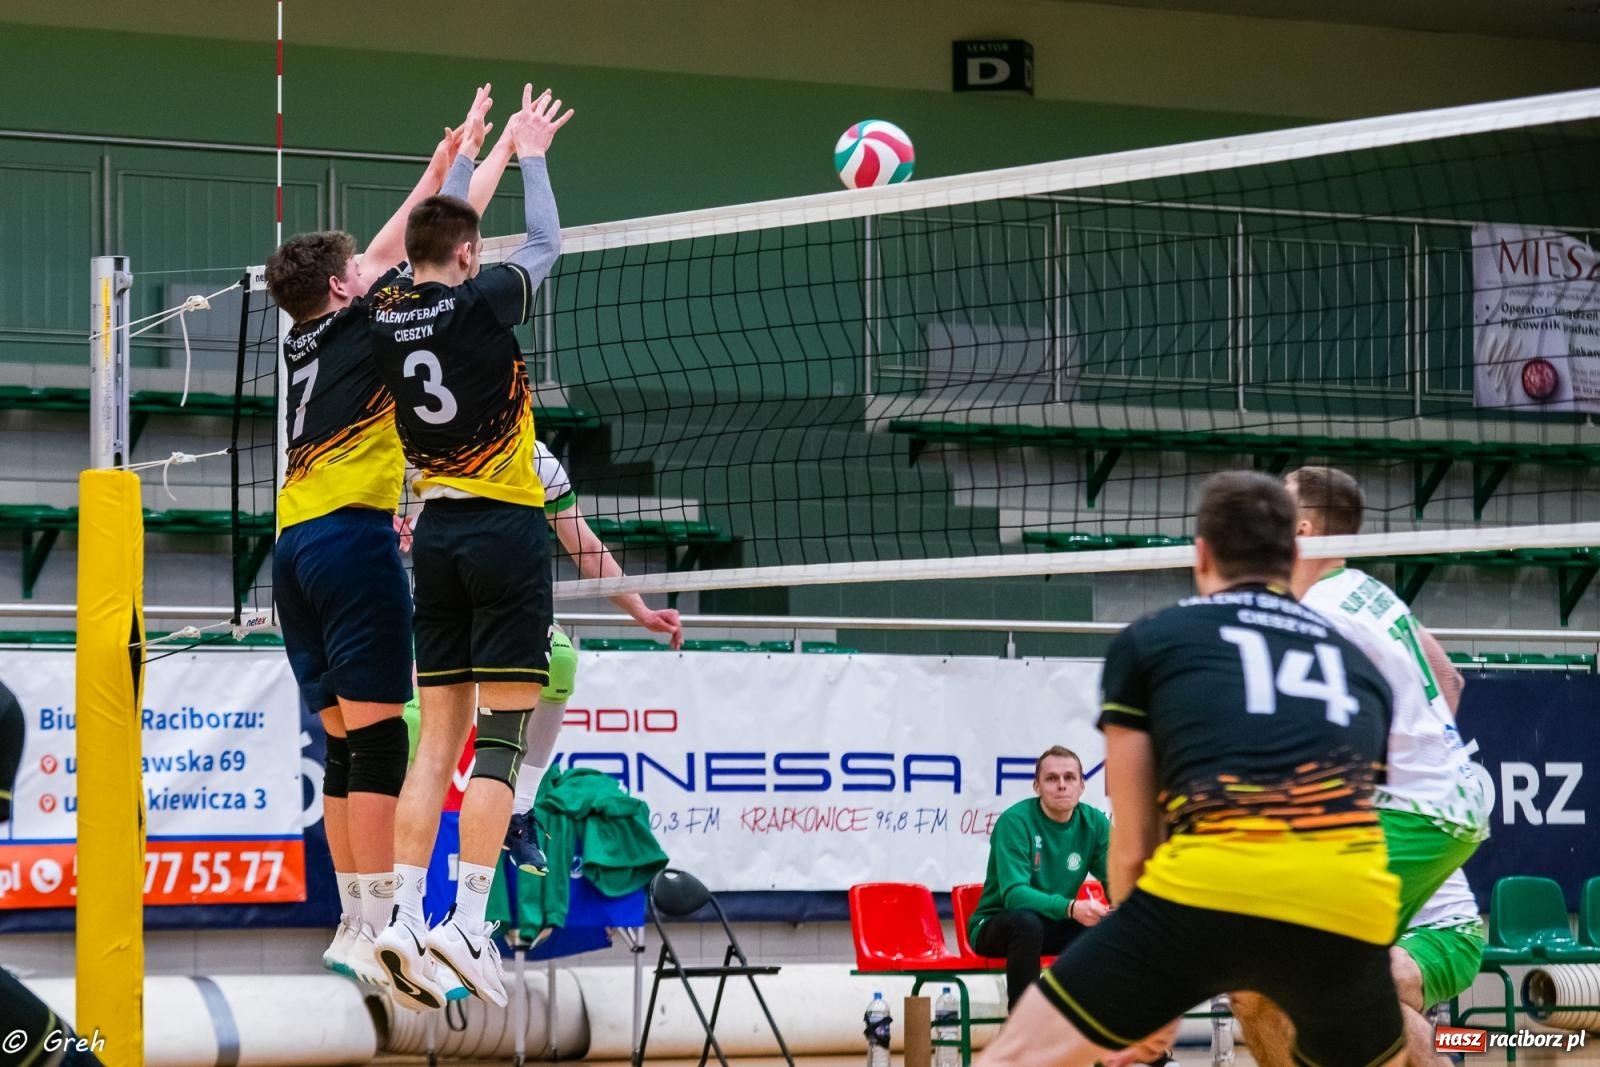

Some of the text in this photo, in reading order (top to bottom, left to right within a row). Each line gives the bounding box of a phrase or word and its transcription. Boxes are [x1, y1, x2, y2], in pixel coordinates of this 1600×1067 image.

[967, 58, 1010, 85] D
[394, 324, 434, 342] CIESZYN
[291, 357, 319, 440] 7
[403, 350, 457, 424] 3
[1218, 625, 1360, 727] 14
[40, 709, 265, 730] Biu Raciborzu:
[562, 709, 677, 732] ADIO
[141, 749, 245, 773] awska 69
[549, 752, 961, 794] ANESSA
[148, 788, 267, 810] kiewicza 3
[651, 811, 679, 834] 0,3
[685, 807, 721, 834] FM
[914, 807, 949, 834] FM
[960, 809, 996, 835] OLE
[190, 852, 231, 893] 55
[240, 851, 284, 892] 77
